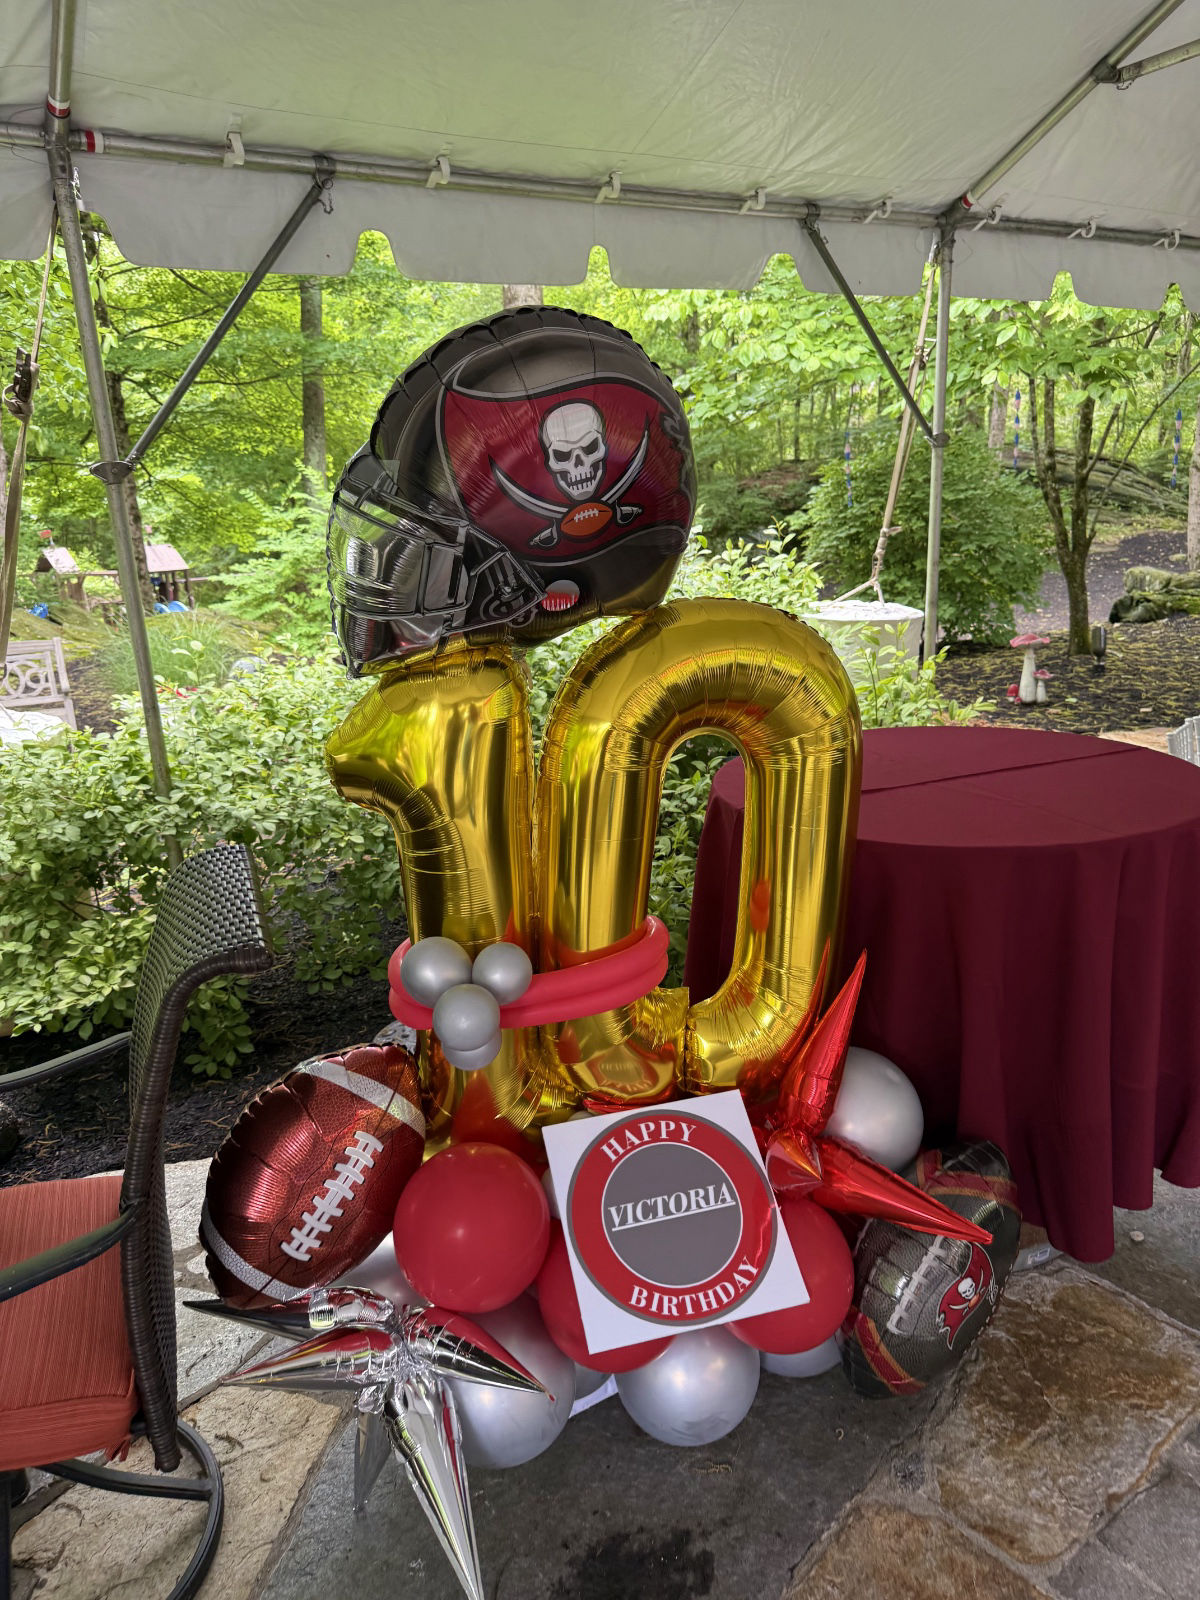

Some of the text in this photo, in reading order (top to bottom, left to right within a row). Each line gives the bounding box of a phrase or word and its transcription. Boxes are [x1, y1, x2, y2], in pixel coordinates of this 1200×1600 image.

[326, 597, 862, 1146] 10
[601, 1120, 697, 1163] HAPPY
[608, 1182, 735, 1229] VICTORIA
[630, 1256, 759, 1316] BIRTHDAY
